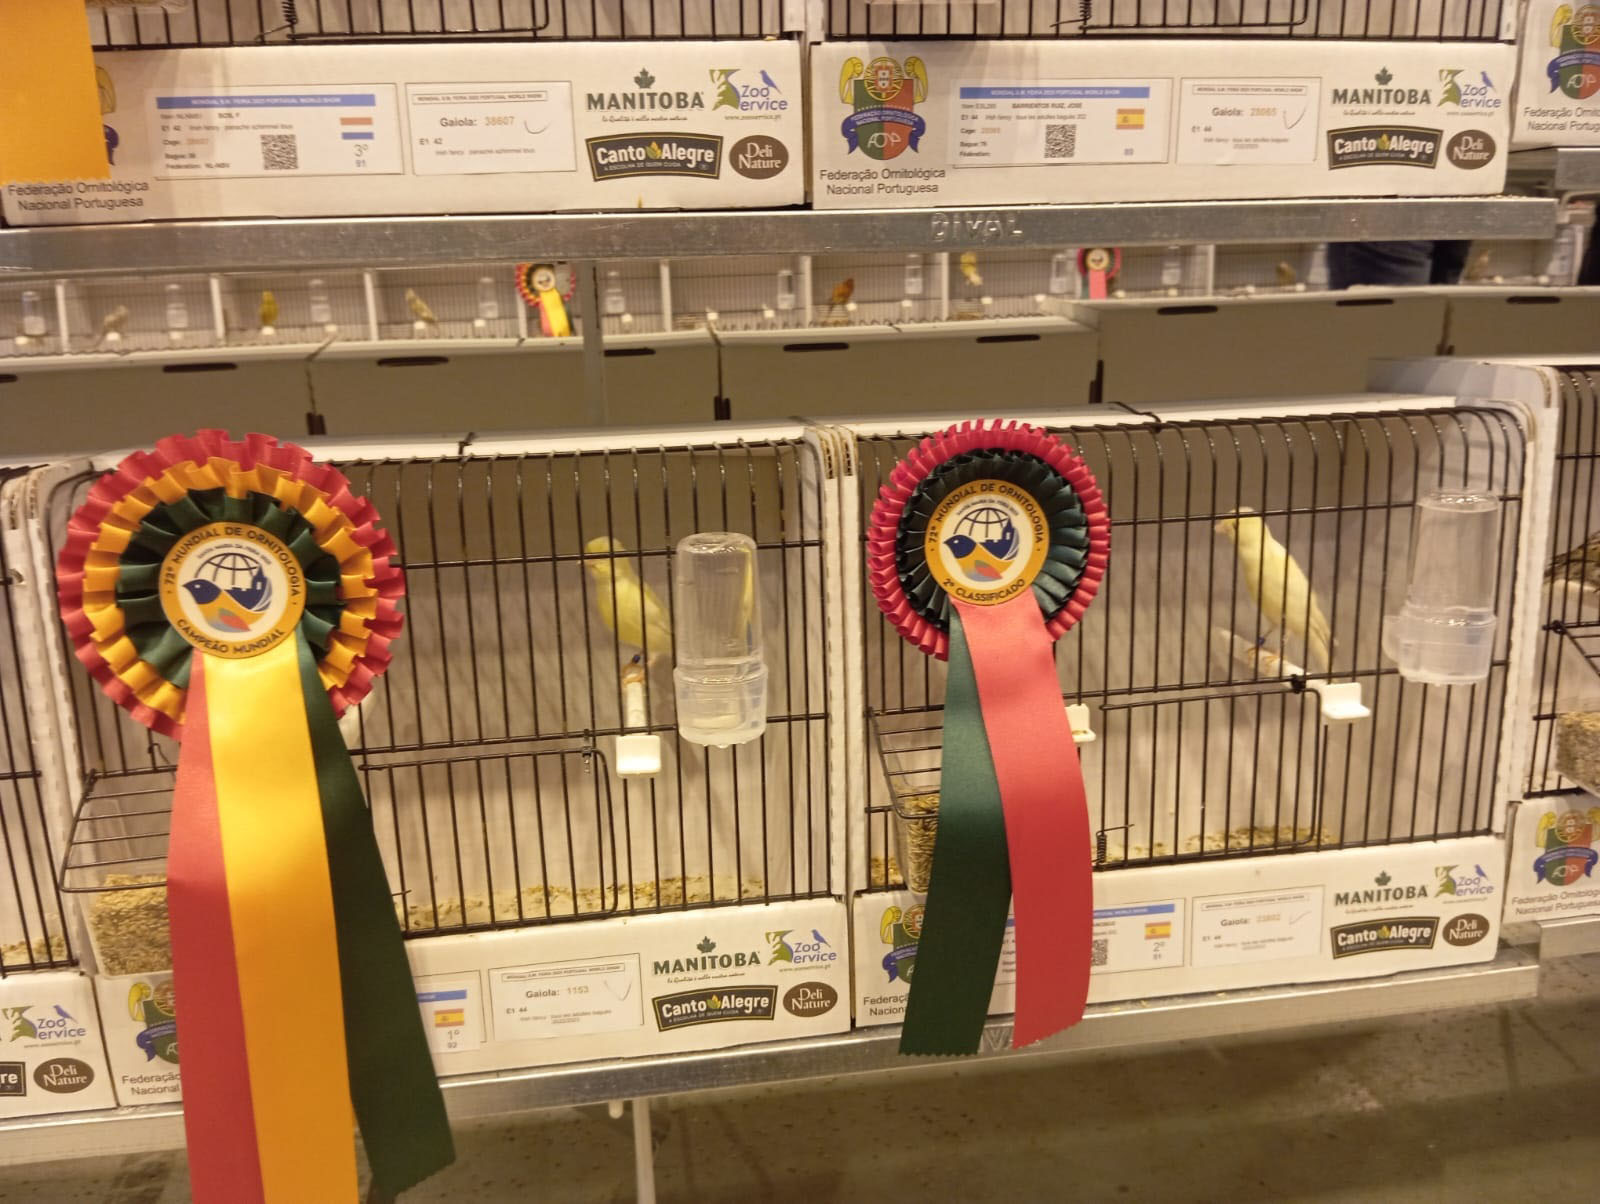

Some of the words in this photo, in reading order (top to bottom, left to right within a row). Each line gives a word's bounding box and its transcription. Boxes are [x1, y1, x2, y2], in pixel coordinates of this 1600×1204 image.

[742, 85, 769, 98] Zoo
[1333, 89, 1431, 104] MANITOBA
[1463, 84, 1488, 96] Zoo
[586, 92, 704, 110] MANITOBA
[440, 117, 477, 127] Gaiola:
[746, 142, 773, 158] Deli
[1334, 137, 1377, 155] Canto
[1388, 135, 1435, 159] Alegre
[1461, 136, 1484, 151] Deli
[596, 145, 646, 165] Canto
[661, 142, 715, 169] Alegre
[738, 153, 782, 169] Nature
[1453, 147, 1490, 161] Nature
[820, 169, 878, 182] Federação
[881, 168, 946, 181] Ornitológica
[8, 183, 73, 197] Federação
[76, 181, 149, 195] Ornitológica
[827, 184, 874, 195] Nacional
[877, 183, 939, 196] Portuguesa
[18, 200, 71, 211] Nacional
[74, 197, 144, 211] Portuguesa
[936, 485, 977, 523] MUNDIAL
[980, 483, 996, 492] DE
[998, 484, 1045, 544] ORNITOLOGIA
[174, 528, 221, 564] MUNDIAL
[224, 526, 243, 536] DE
[247, 529, 301, 598] ORNITOLOGIA
[955, 578, 1026, 602] CLASSIFICADO
[177, 618, 229, 654] CAMPEÃO
[232, 628, 286, 654] MUNDIAL
[1458, 876, 1481, 888] Zoo
[1334, 884, 1429, 907] MANITOBA
[1457, 918, 1478, 931] Deli
[1336, 929, 1377, 946] Canto
[1388, 924, 1432, 944] Alegre
[1449, 927, 1485, 941] Nature
[794, 942, 820, 954] Zoo
[653, 951, 761, 976] MANITOBA
[525, 988, 561, 1000] Gaiola:
[799, 987, 823, 1002] Deli
[661, 999, 707, 1018] Canto
[720, 993, 770, 1016] Alegre
[791, 997, 831, 1012] Nature
[37, 1018, 67, 1030] Zoo
[50, 1064, 78, 1077] Deli
[43, 1073, 88, 1087] Nature
[131, 1085, 180, 1096] Nacional
